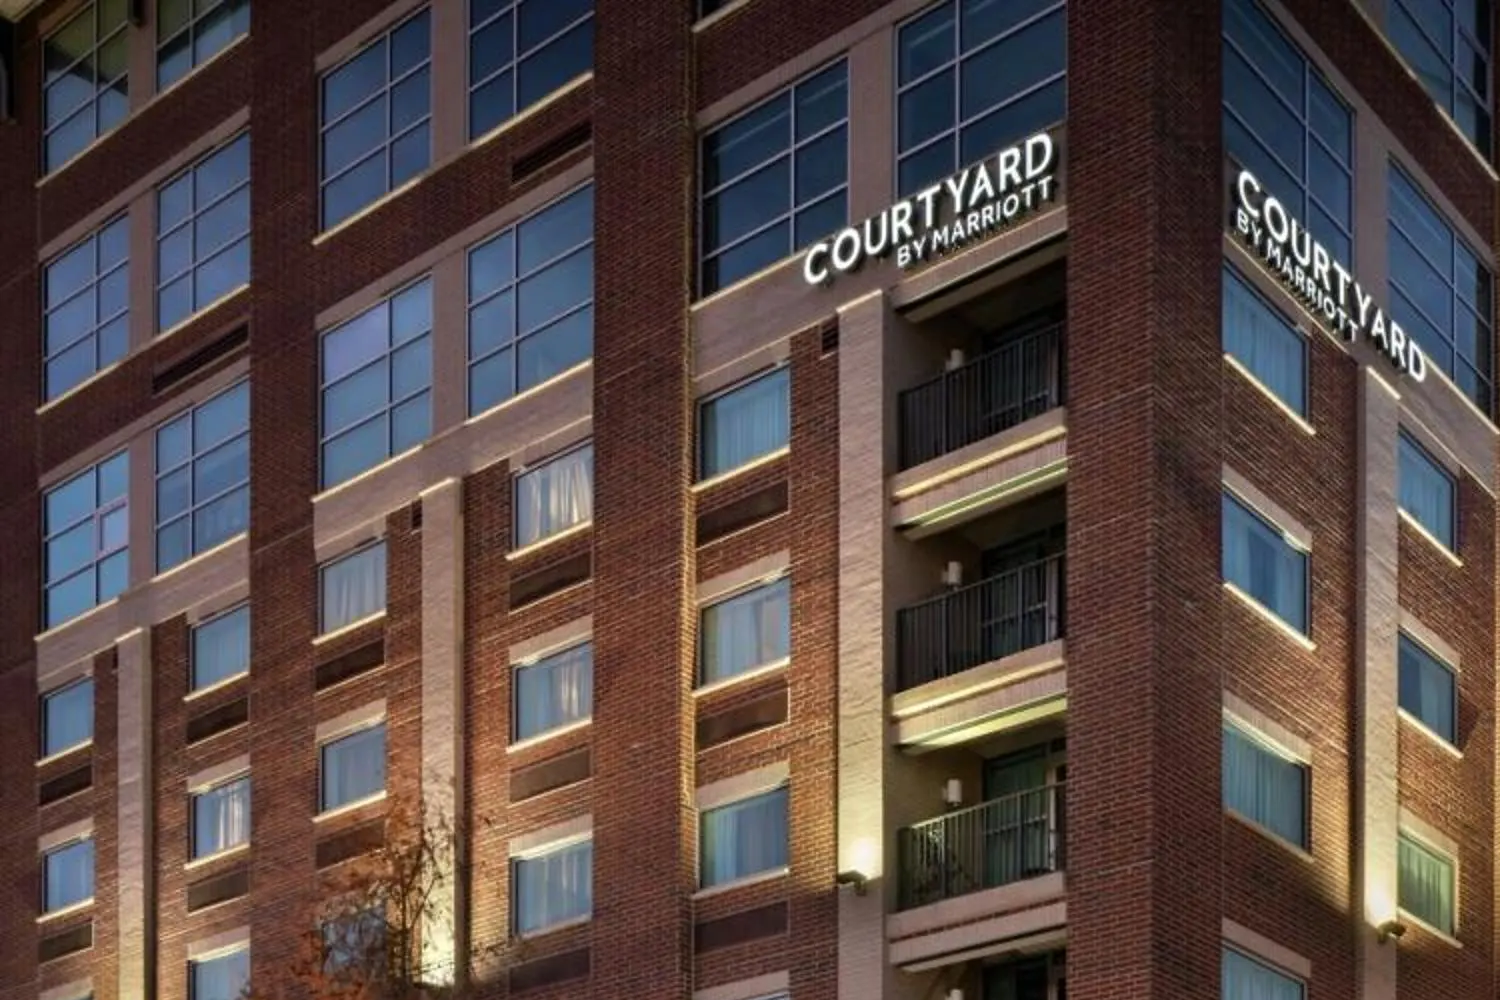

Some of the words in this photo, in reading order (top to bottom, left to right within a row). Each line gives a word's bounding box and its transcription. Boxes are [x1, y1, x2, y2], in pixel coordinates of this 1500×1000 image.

[803, 133, 1053, 285] COURTYARD
[897, 236, 928, 268] BY
[931, 175, 1053, 250] MARRIOTT
[1237, 208, 1262, 247] BY
[1266, 238, 1359, 344] MARRIOTT
[1238, 170, 1426, 383] COURTYARD
